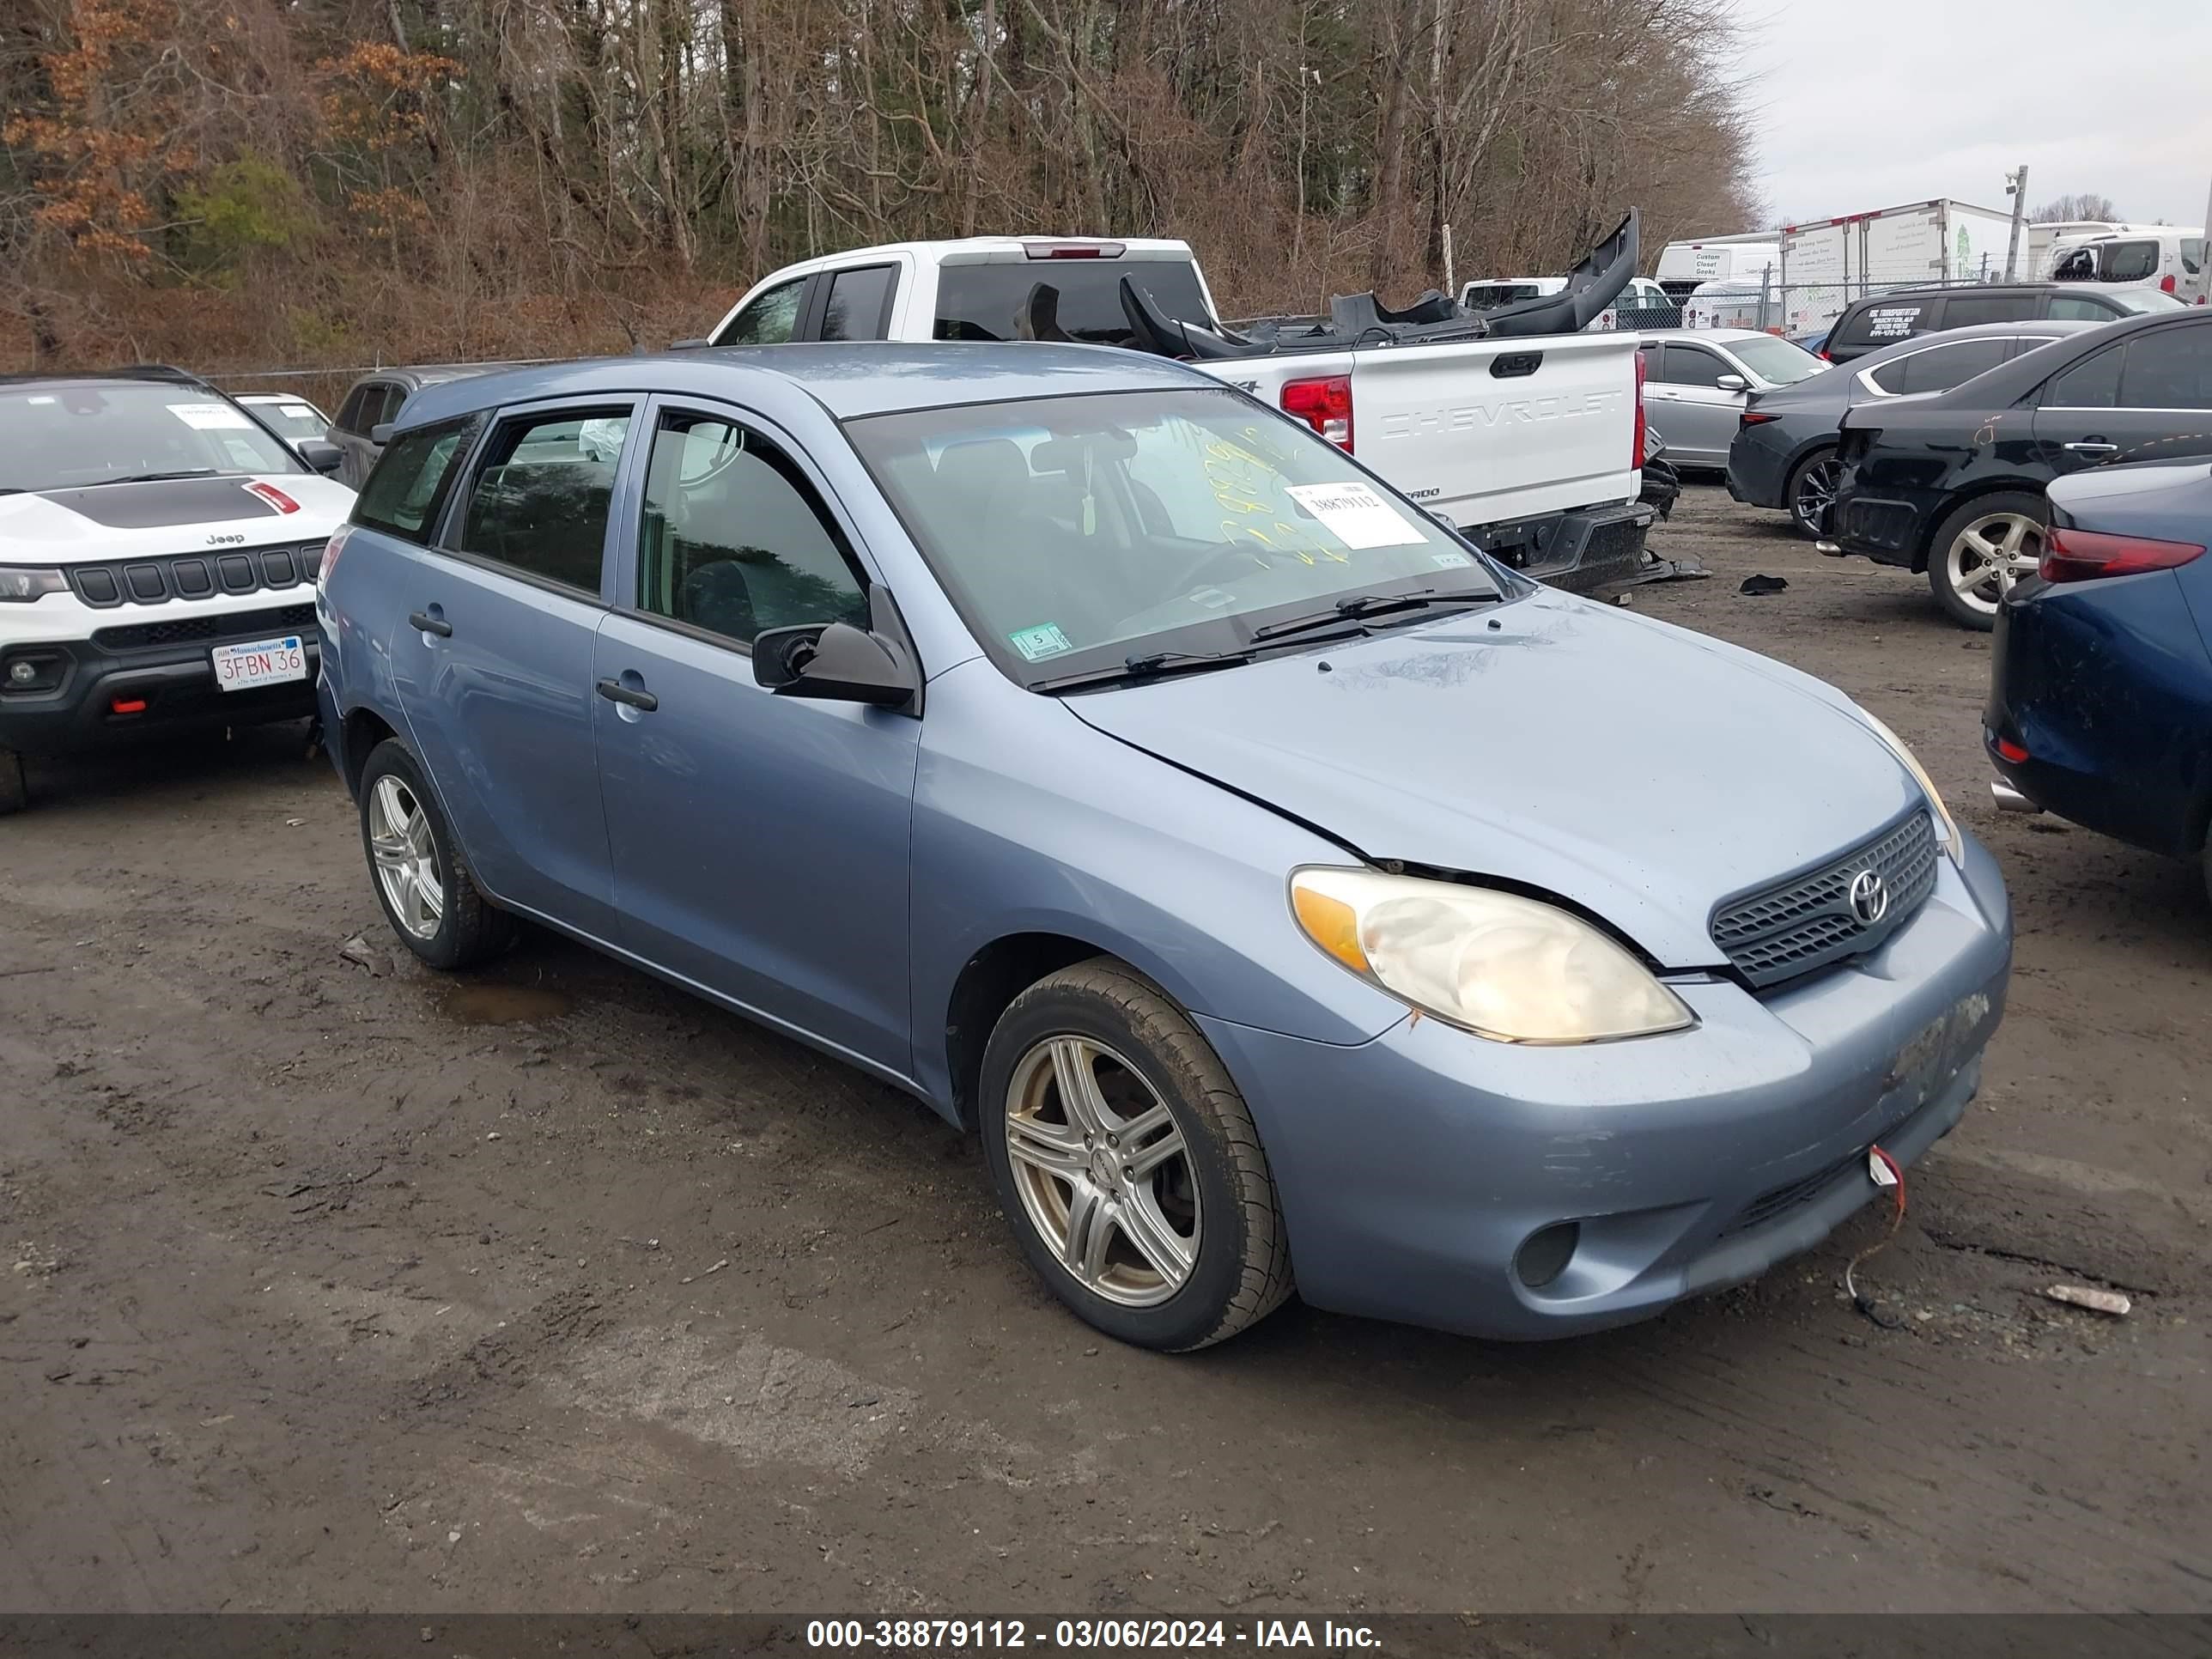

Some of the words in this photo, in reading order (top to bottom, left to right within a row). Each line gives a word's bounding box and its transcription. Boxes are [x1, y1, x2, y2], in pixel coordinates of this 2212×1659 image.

[1380, 390, 1622, 440] CHEVROLET
[1310, 495, 1380, 512] 38879112
[206, 532, 245, 545] Jeep
[1033, 635, 1043, 644] 5
[233, 642, 282, 654] Massachusetts
[220, 653, 272, 679] 3FBN
[275, 649, 301, 671] 36
